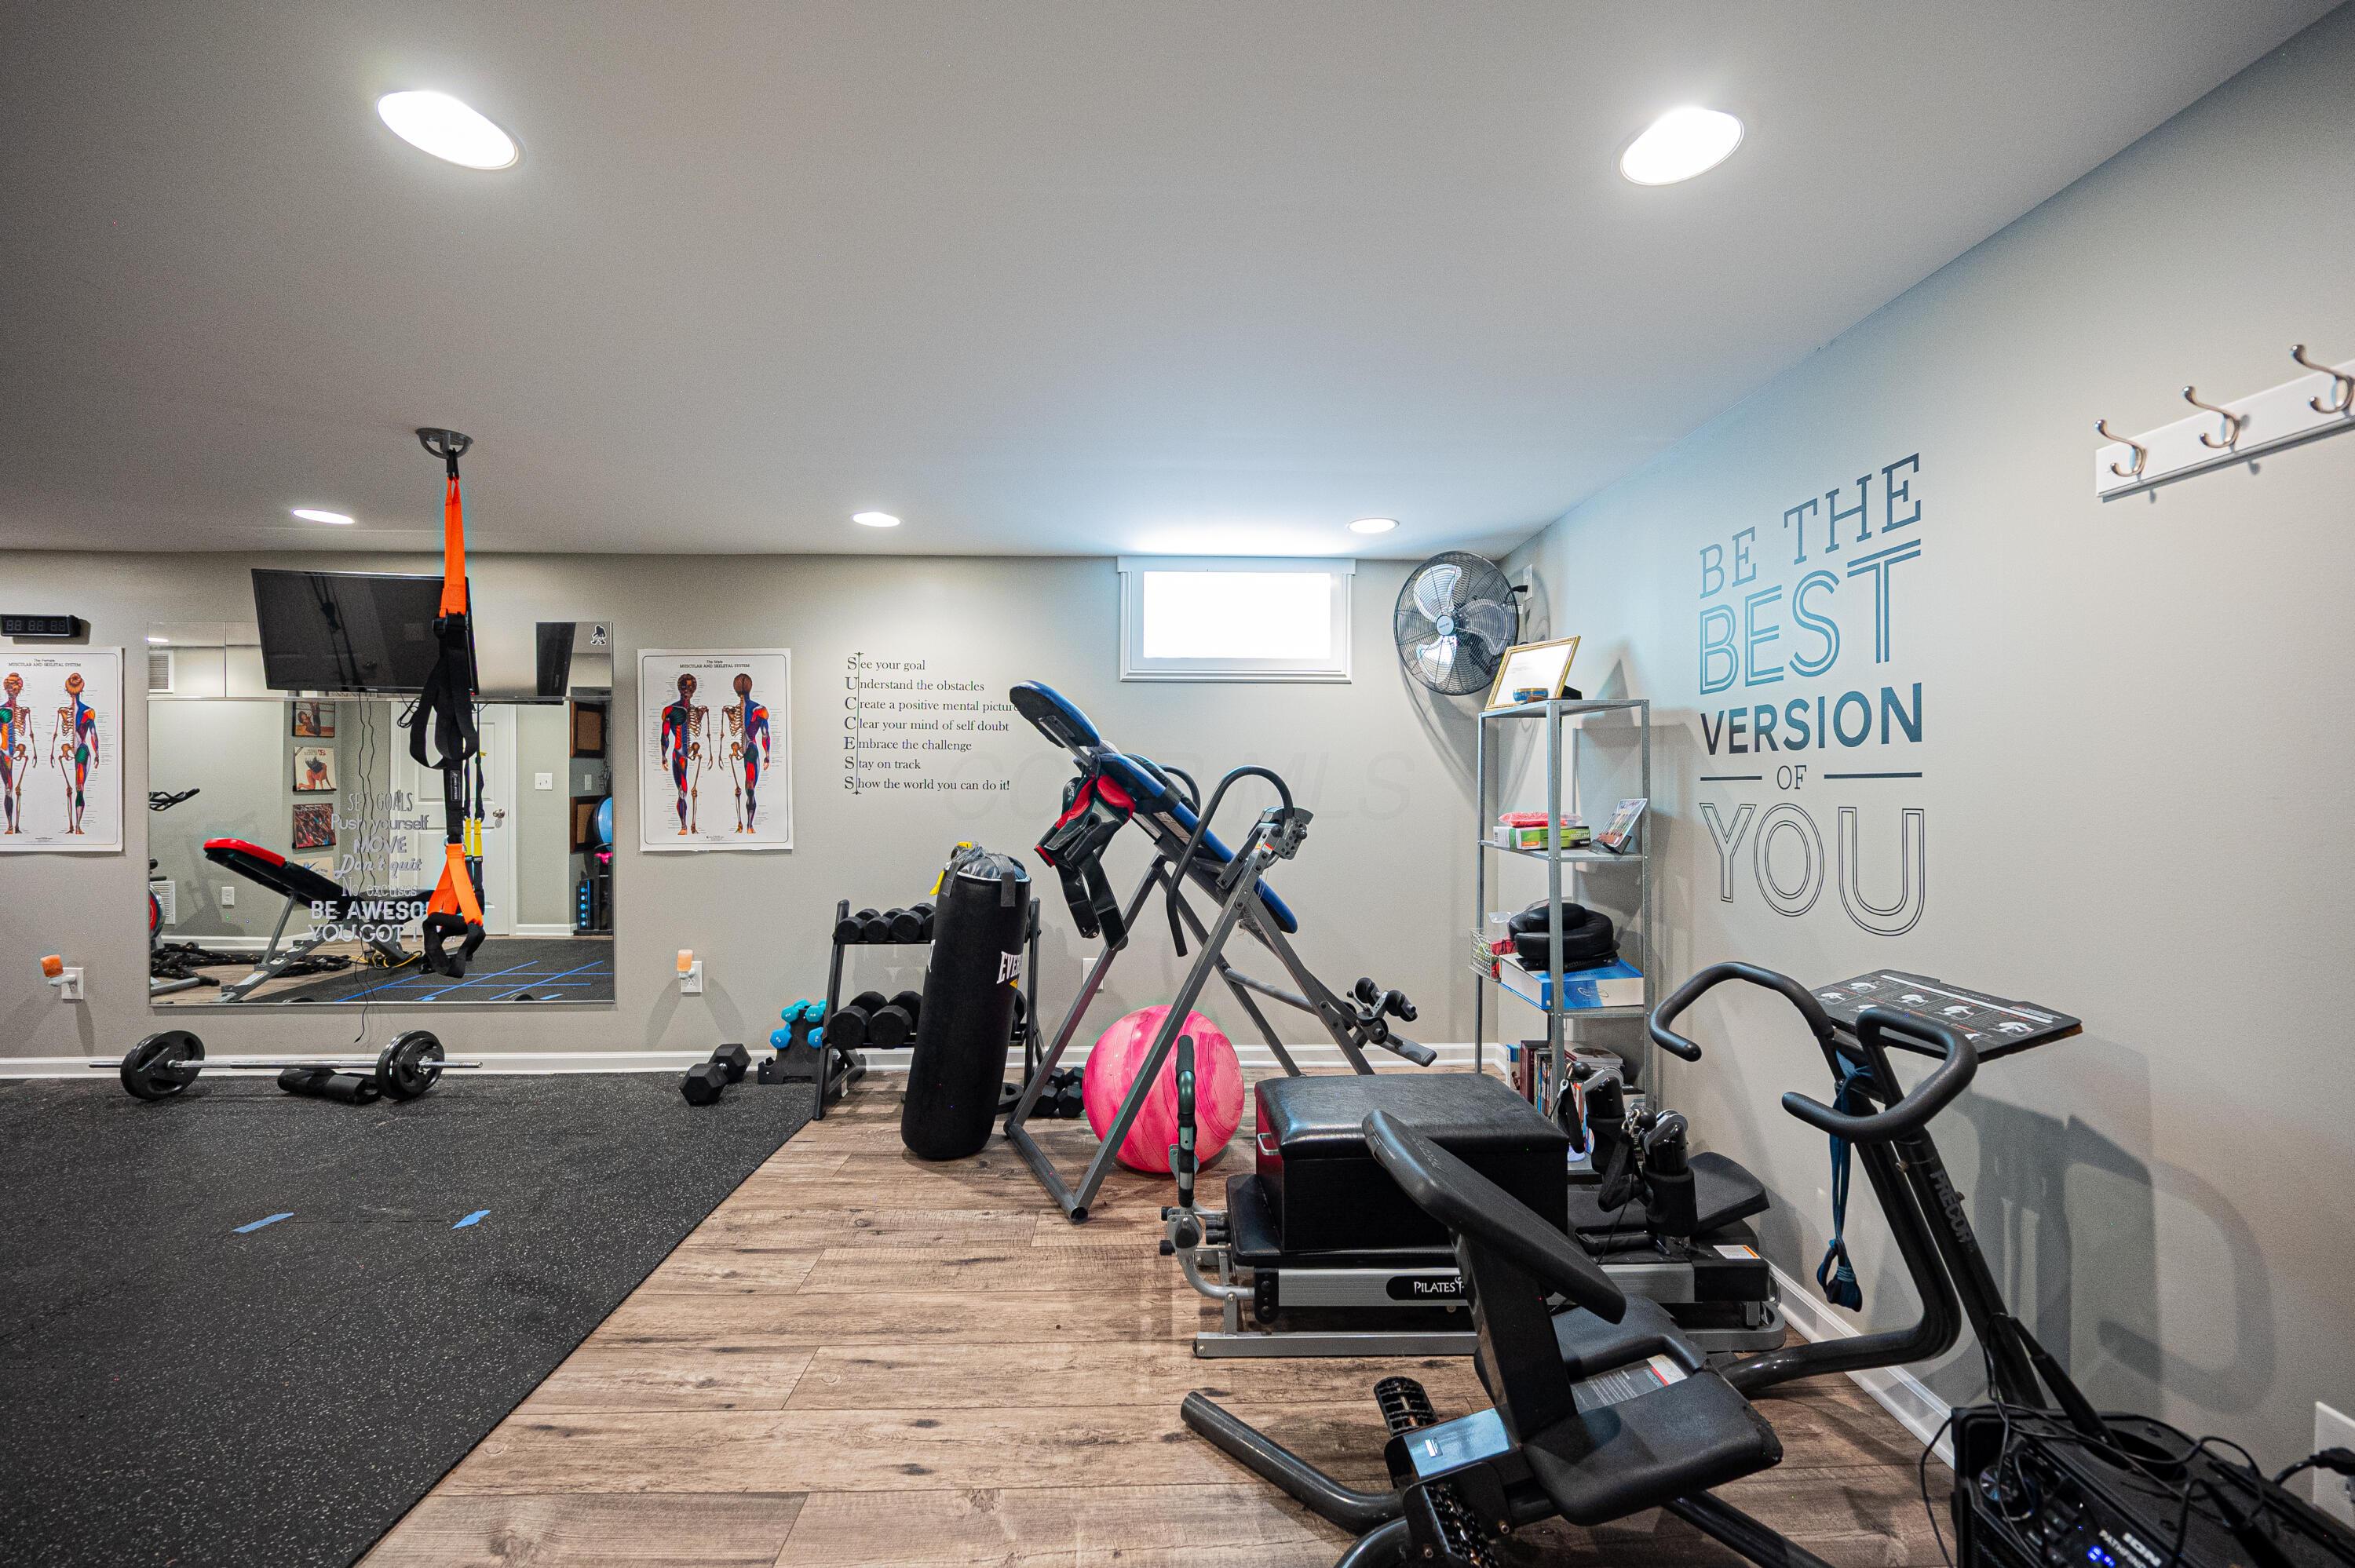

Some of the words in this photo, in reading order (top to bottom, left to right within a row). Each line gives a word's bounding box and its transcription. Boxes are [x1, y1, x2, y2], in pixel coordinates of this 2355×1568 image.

[1700, 527, 1756, 599] BE
[1784, 452, 1922, 566] THE
[1700, 538, 1922, 695] BEST
[876, 662, 901, 672] your
[904, 660, 926, 672] goal
[845, 676, 913, 690] Understand
[917, 680, 933, 691] the
[937, 680, 984, 691] obstacles
[845, 696, 885, 709] Create
[899, 699, 939, 712] positive
[943, 700, 980, 711] mental
[844, 717, 879, 730] Clear
[882, 722, 907, 731] your
[911, 720, 939, 730] mind
[942, 720, 955, 730] of
[956, 720, 976, 731] self
[977, 720, 1010, 731] doubt
[1700, 682, 1922, 757] VERSION
[843, 736, 898, 749] Embrace
[902, 739, 918, 750] the
[922, 739, 972, 753] challenge
[845, 756, 874, 771] Stay
[877, 760, 891, 769] on
[894, 759, 922, 769] track
[844, 776, 881, 789] Show
[884, 779, 900, 789] the
[904, 779, 934, 790] world
[937, 782, 957, 792] you
[960, 782, 979, 790] can
[982, 779, 996, 791] do
[999, 780, 1010, 791] it!
[1776, 764, 1807, 790] OF
[377, 789, 413, 811] GOALS
[330, 813, 366, 830] Push
[371, 815, 429, 835] yourself
[353, 835, 407, 854] MOVE
[334, 854, 386, 879] Don't
[389, 858, 422, 879] quit
[1699, 802, 1925, 936] YOU
[341, 877, 359, 897] No
[367, 884, 418, 897] excuses
[311, 901, 338, 920] BE
[347, 901, 429, 920] AWESO
[308, 924, 358, 943] YOU
[362, 924, 406, 943] GOT
[1930, 1168, 1974, 1243] PRECOR
[1414, 1281, 1456, 1294] PILATES
